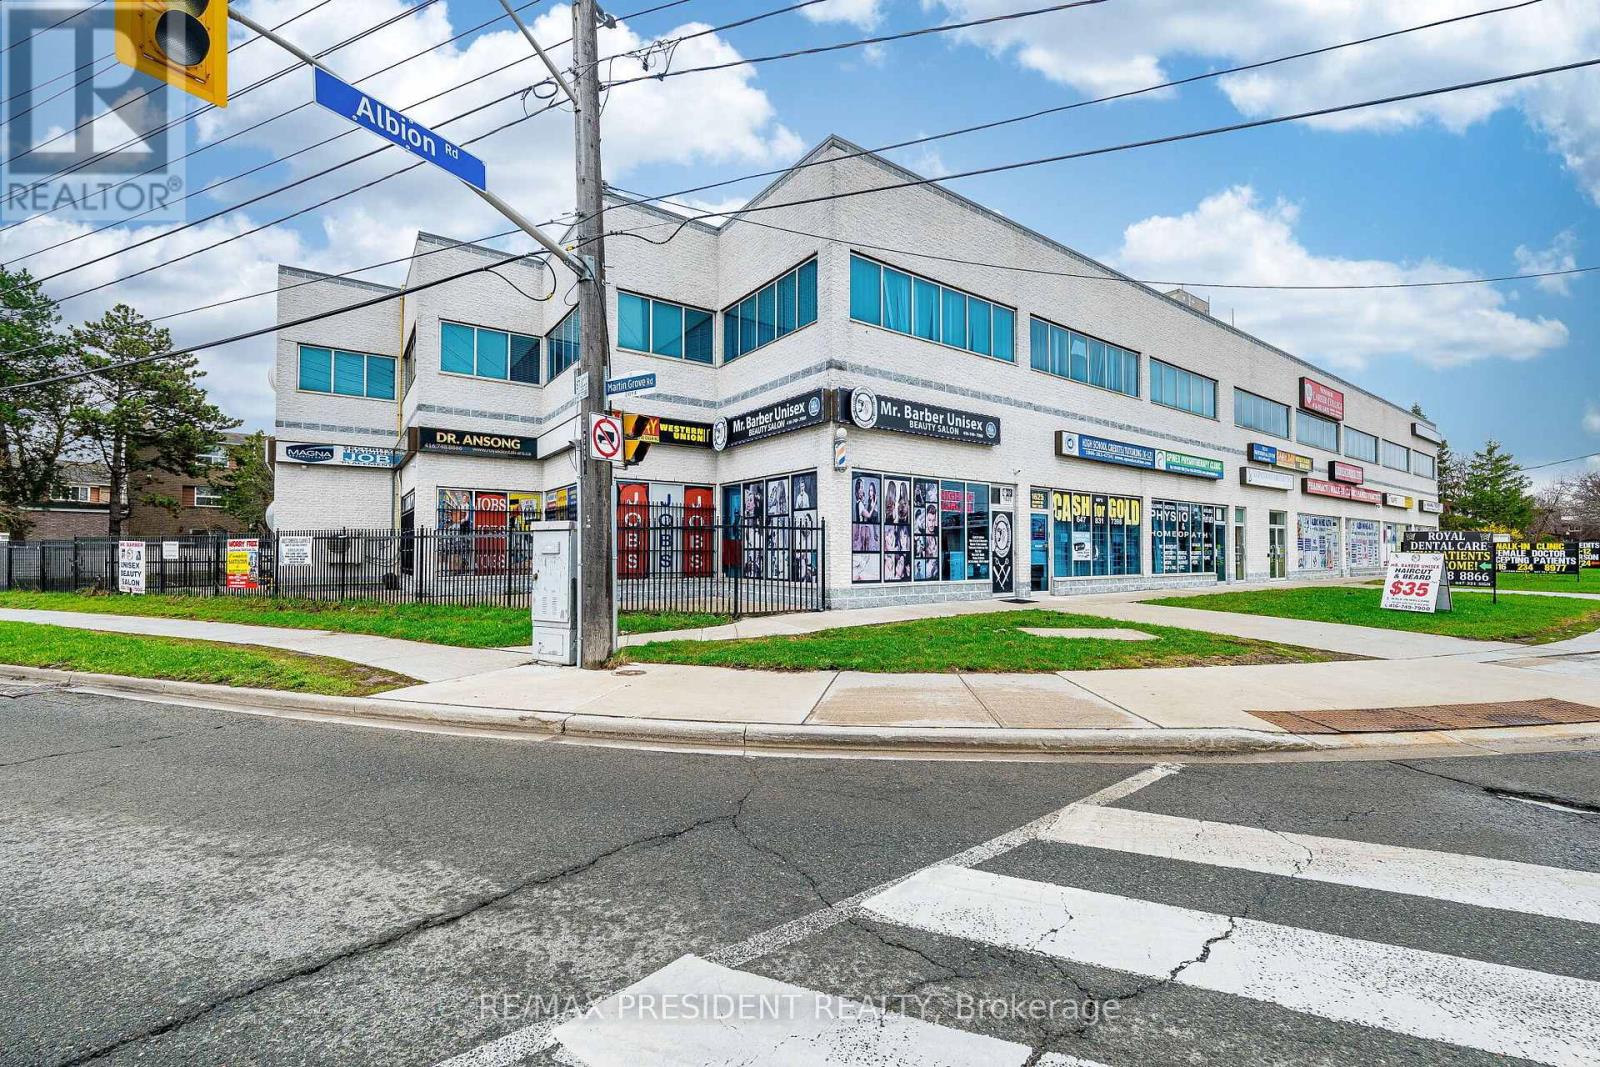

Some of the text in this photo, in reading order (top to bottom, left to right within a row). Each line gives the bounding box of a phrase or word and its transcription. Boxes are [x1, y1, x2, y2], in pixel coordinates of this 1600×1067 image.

[356, 96, 459, 160] Albion Rd
[607, 381, 627, 392] Martin
[628, 379, 646, 389] Grove
[732, 420, 745, 433] Mr.
[746, 412, 773, 429] Barber
[774, 402, 805, 420] Unisex
[880, 401, 983, 431] Mr. Barber Unisex
[660, 423, 704, 435] WESTERN
[748, 424, 767, 436] BEAUTY
[768, 419, 785, 432] SALON
[909, 420, 936, 433] BEAUTY
[937, 425, 960, 436] SALON
[436, 431, 521, 449] DR. ANSONG
[673, 432, 704, 442] UNION
[287, 449, 332, 458] MAGNA
[343, 452, 390, 463] JOB
[475, 497, 507, 511] JOBS
[1053, 492, 1140, 526] CASH for GOLD
[1151, 509, 1188, 522] PHYSIO
[1428, 532, 1465, 541] ROYAL
[1410, 541, 1488, 551] DENTAL CARE
[1536, 542, 1564, 550] CLINIC
[1496, 556, 1576, 565] CEPTING PATIENTS
[120, 570, 141, 578] BEAUTY
[1460, 571, 1489, 582] 8866
[121, 577, 140, 586] SALON
[1389, 580, 1430, 597] $35
